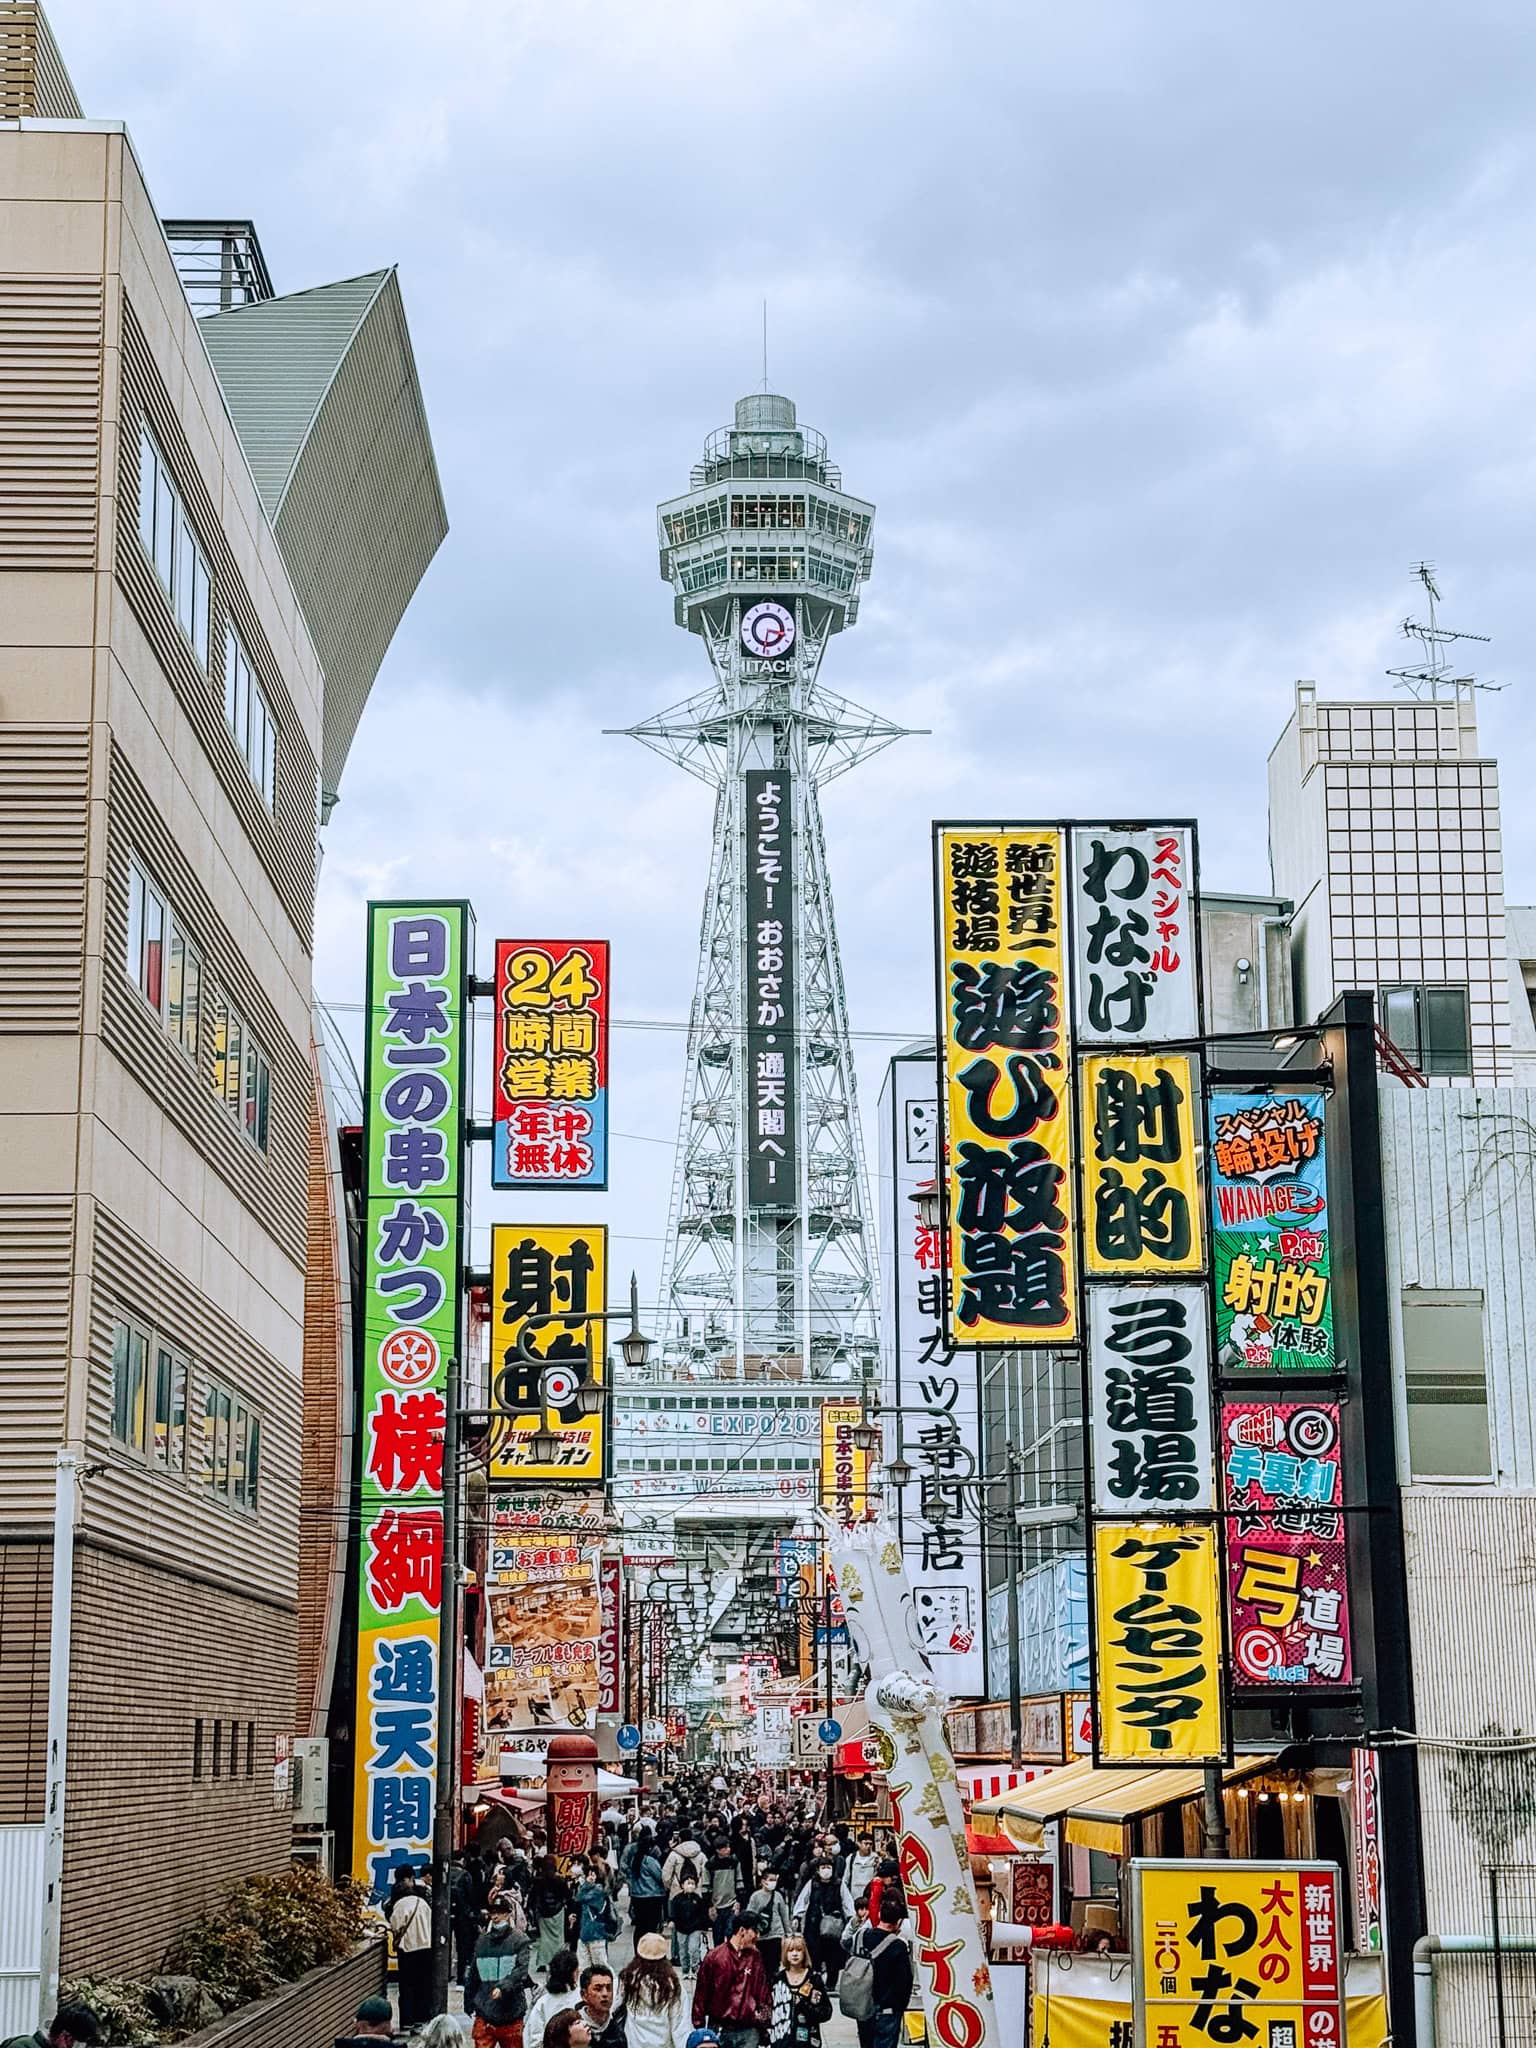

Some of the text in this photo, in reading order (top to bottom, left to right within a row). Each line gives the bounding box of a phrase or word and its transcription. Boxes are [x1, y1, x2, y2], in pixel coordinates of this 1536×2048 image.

[735, 660, 803, 673] HITACH
[951, 843, 1000, 952] 遊技場
[1005, 844, 1057, 951] 新世界一
[1152, 837, 1182, 973] スペシャル
[1083, 840, 1157, 1032] わなげ
[507, 950, 599, 1007] 24
[509, 1012, 595, 1053] 時間
[506, 1059, 596, 1099] 営業
[380, 918, 447, 1321] 日本一の串かつ
[515, 1112, 588, 1141] 年中
[951, 961, 1071, 1328] 遊び放題
[1215, 1121, 1319, 1176] 輪投げ
[1216, 1101, 1305, 1136] スペシャル
[515, 1146, 587, 1172] 無休
[1094, 1068, 1191, 1262] 射的
[1216, 1185, 1297, 1227] WANAGE
[1279, 1232, 1323, 1259] PAN!
[1224, 1254, 1327, 1325] 射的
[502, 1238, 594, 1424] 射的
[1272, 1323, 1330, 1357] 体験
[915, 1178, 964, 1571] 祖串カツ専門店
[1104, 1299, 1200, 1500] 弓道場
[500, 1447, 592, 1465] チャオン
[502, 1431, 592, 1443] 新世技場
[370, 1393, 446, 1609] 横綱
[1227, 1446, 1337, 1502] 手裏剣
[1273, 1499, 1339, 1540] 道場
[1238, 1548, 1300, 1628] 弓
[1109, 1536, 1207, 1749] ゲームセンター
[1301, 1586, 1345, 1679] 道場
[557, 1797, 587, 1855] 射的
[1259, 1880, 1294, 1984] 大人の
